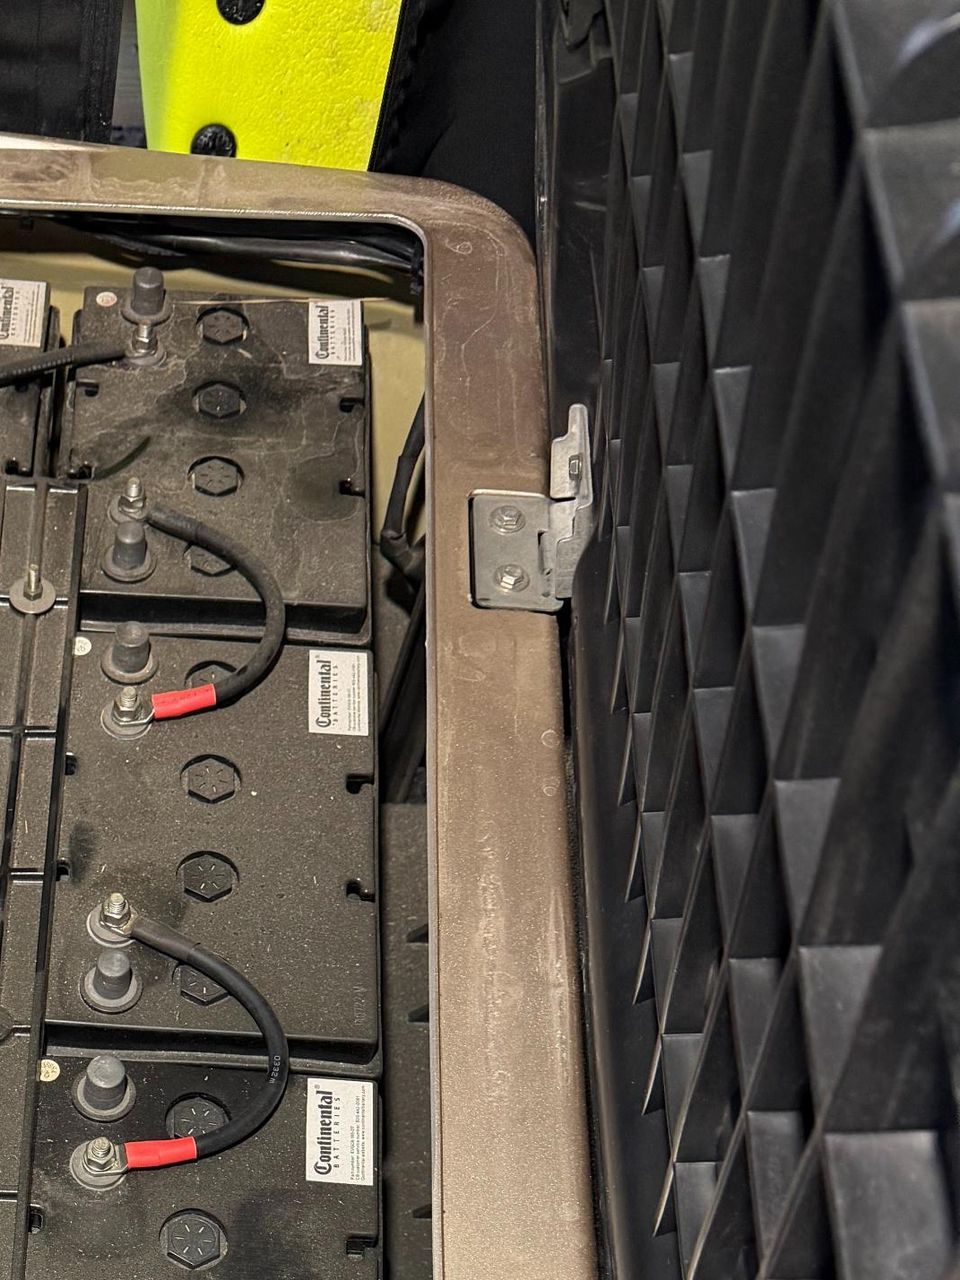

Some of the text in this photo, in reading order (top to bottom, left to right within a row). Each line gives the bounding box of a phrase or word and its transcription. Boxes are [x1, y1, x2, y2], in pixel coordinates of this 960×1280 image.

[314, 305, 329, 359] Continental
[315, 659, 331, 727] Continental
[313, 1090, 332, 1175] Continental
[332, 1097, 340, 1168] BATTERIES
